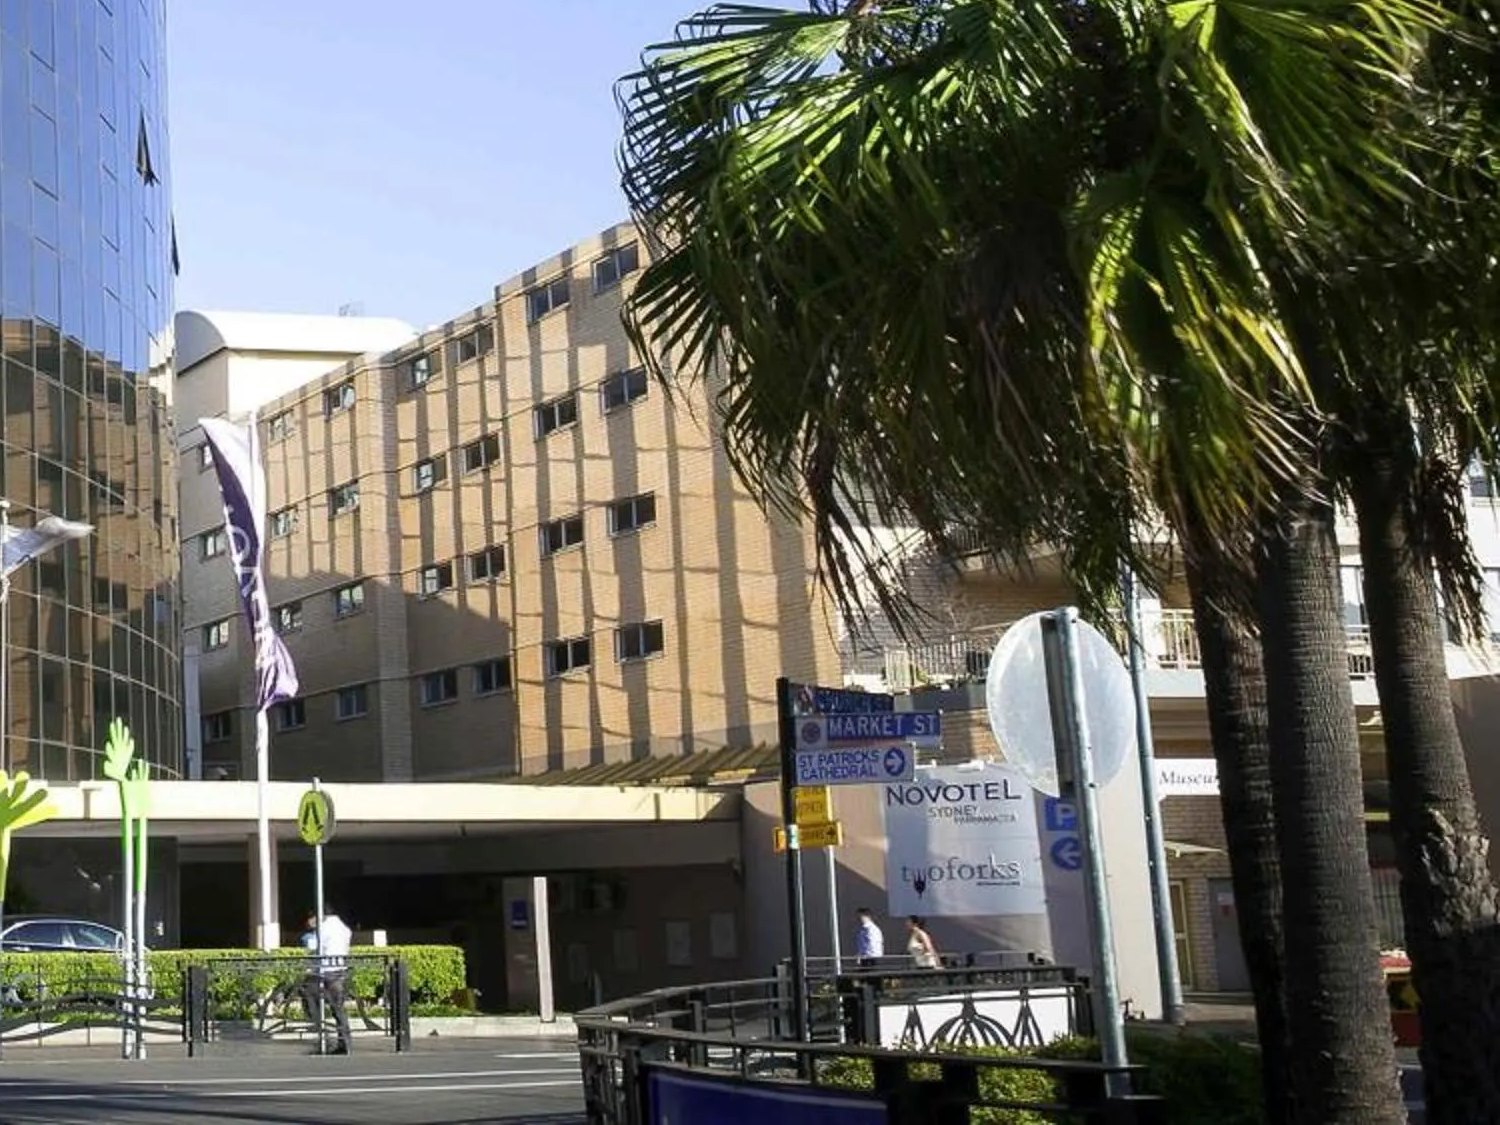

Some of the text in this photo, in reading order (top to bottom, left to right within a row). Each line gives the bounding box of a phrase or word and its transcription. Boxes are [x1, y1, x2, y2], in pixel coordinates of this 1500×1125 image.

[828, 714, 937, 738] MARKET ST
[799, 749, 881, 768] ST PATRICKS
[800, 765, 879, 782] CATHEDRAL
[1159, 771, 1217, 785] Museu
[886, 778, 1022, 806] NOVOTEL
[927, 804, 980, 819] SYDNEY
